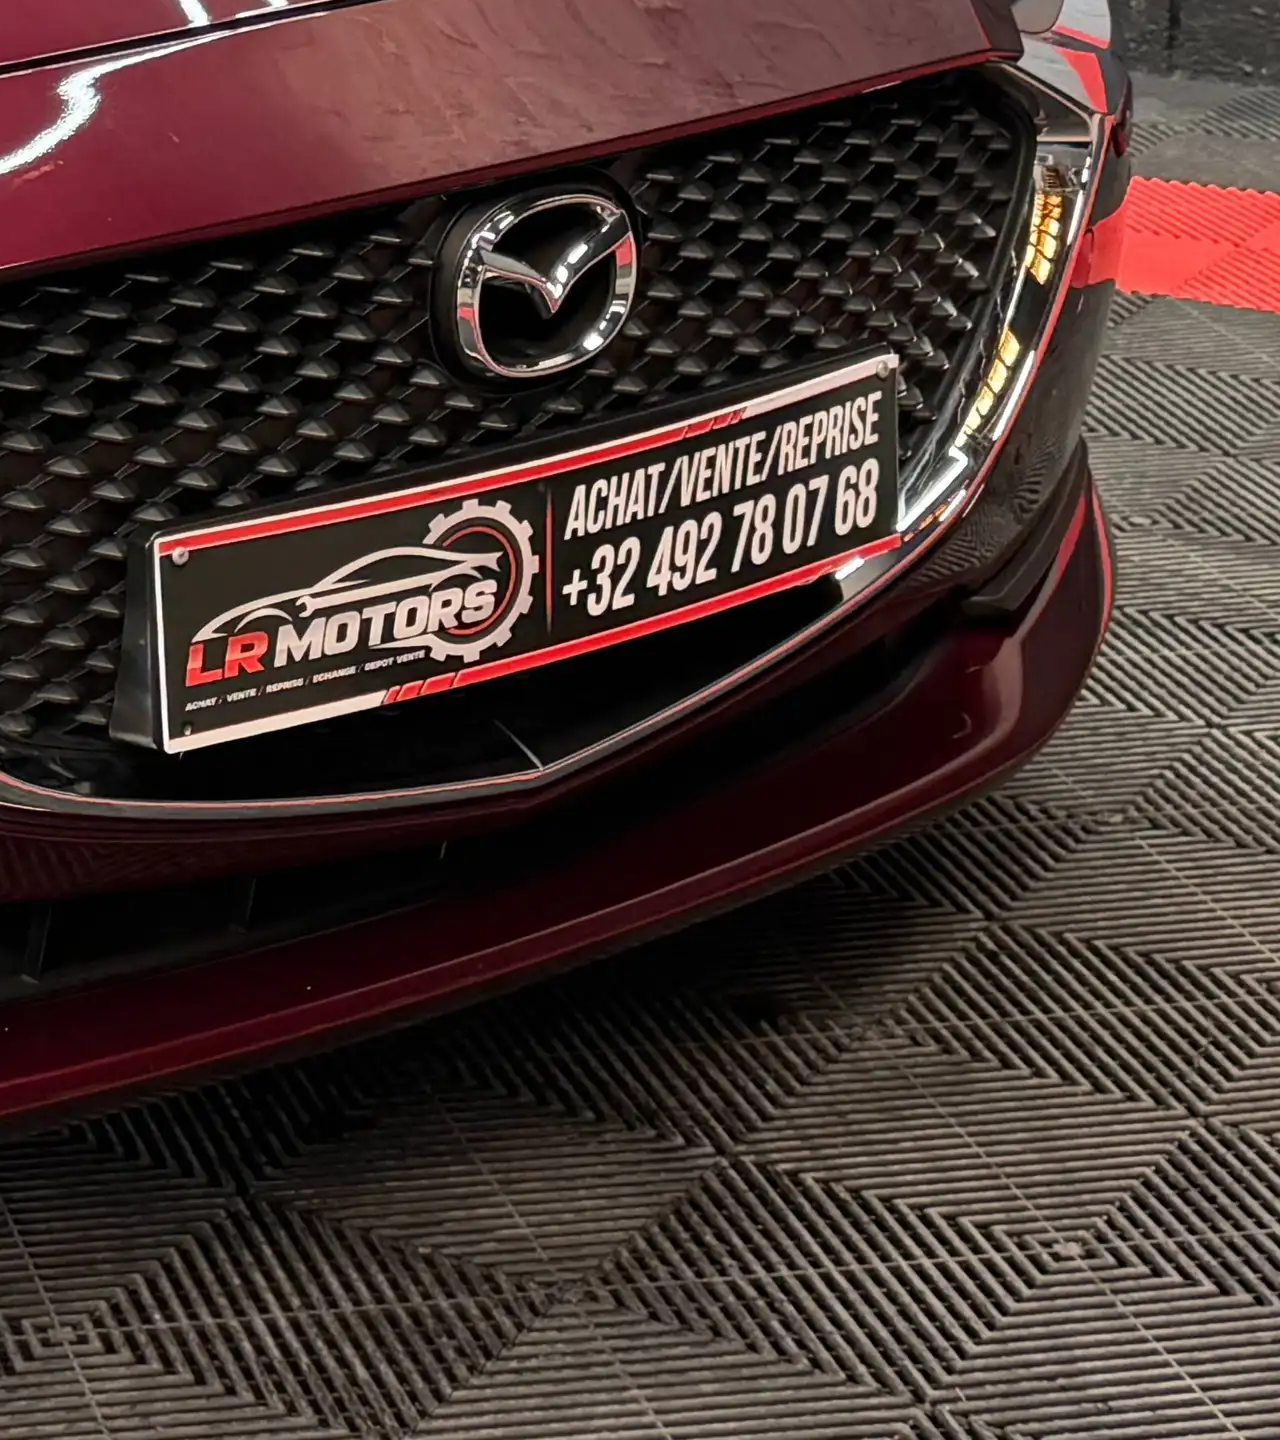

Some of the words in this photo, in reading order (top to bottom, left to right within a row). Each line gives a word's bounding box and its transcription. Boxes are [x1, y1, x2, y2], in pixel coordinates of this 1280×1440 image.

[563, 390, 883, 541] ACHAT/VENTE/REPRISE
[562, 536, 641, 617] +32
[646, 510, 723, 597] 492
[730, 493, 777, 574] 78
[781, 475, 829, 555] 07
[834, 458, 880, 537] 68
[185, 630, 269, 687] LR
[273, 578, 499, 668] MOTORS
[226, 687, 257, 703] VENTE
